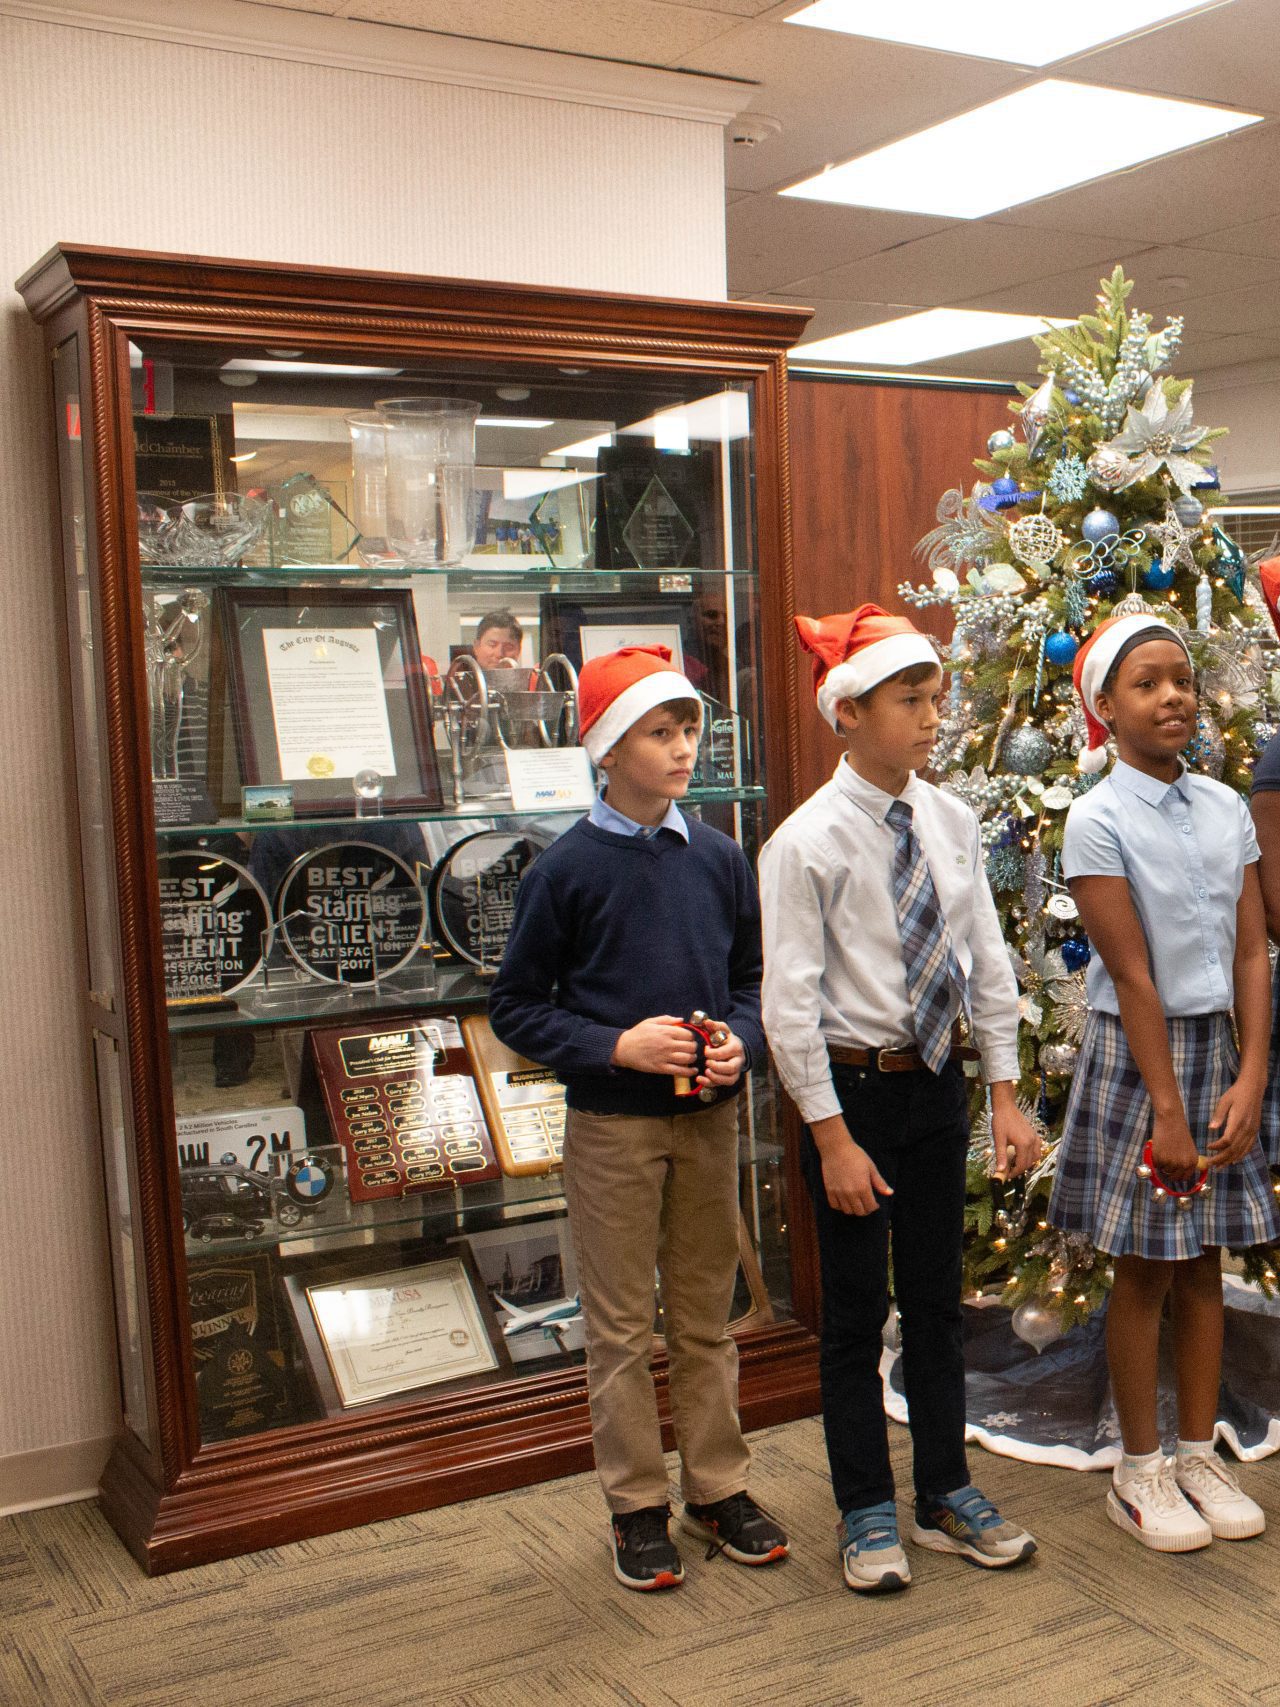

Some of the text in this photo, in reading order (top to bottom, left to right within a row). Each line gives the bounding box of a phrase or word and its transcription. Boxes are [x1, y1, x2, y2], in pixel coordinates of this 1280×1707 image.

[280, 640, 295, 652] The
[296, 636, 313, 645] City
[327, 635, 360, 653] Augusta
[535, 789, 556, 798] MAU
[307, 867, 374, 886] BEST
[158, 877, 215, 898] EST
[333, 887, 344, 899] of
[310, 919, 400, 945] CLIENT
[341, 959, 371, 970] 2017
[194, 1121, 213, 1129] Million
[216, 1124, 234, 1132] South
[234, 1122, 258, 1130] Carolina
